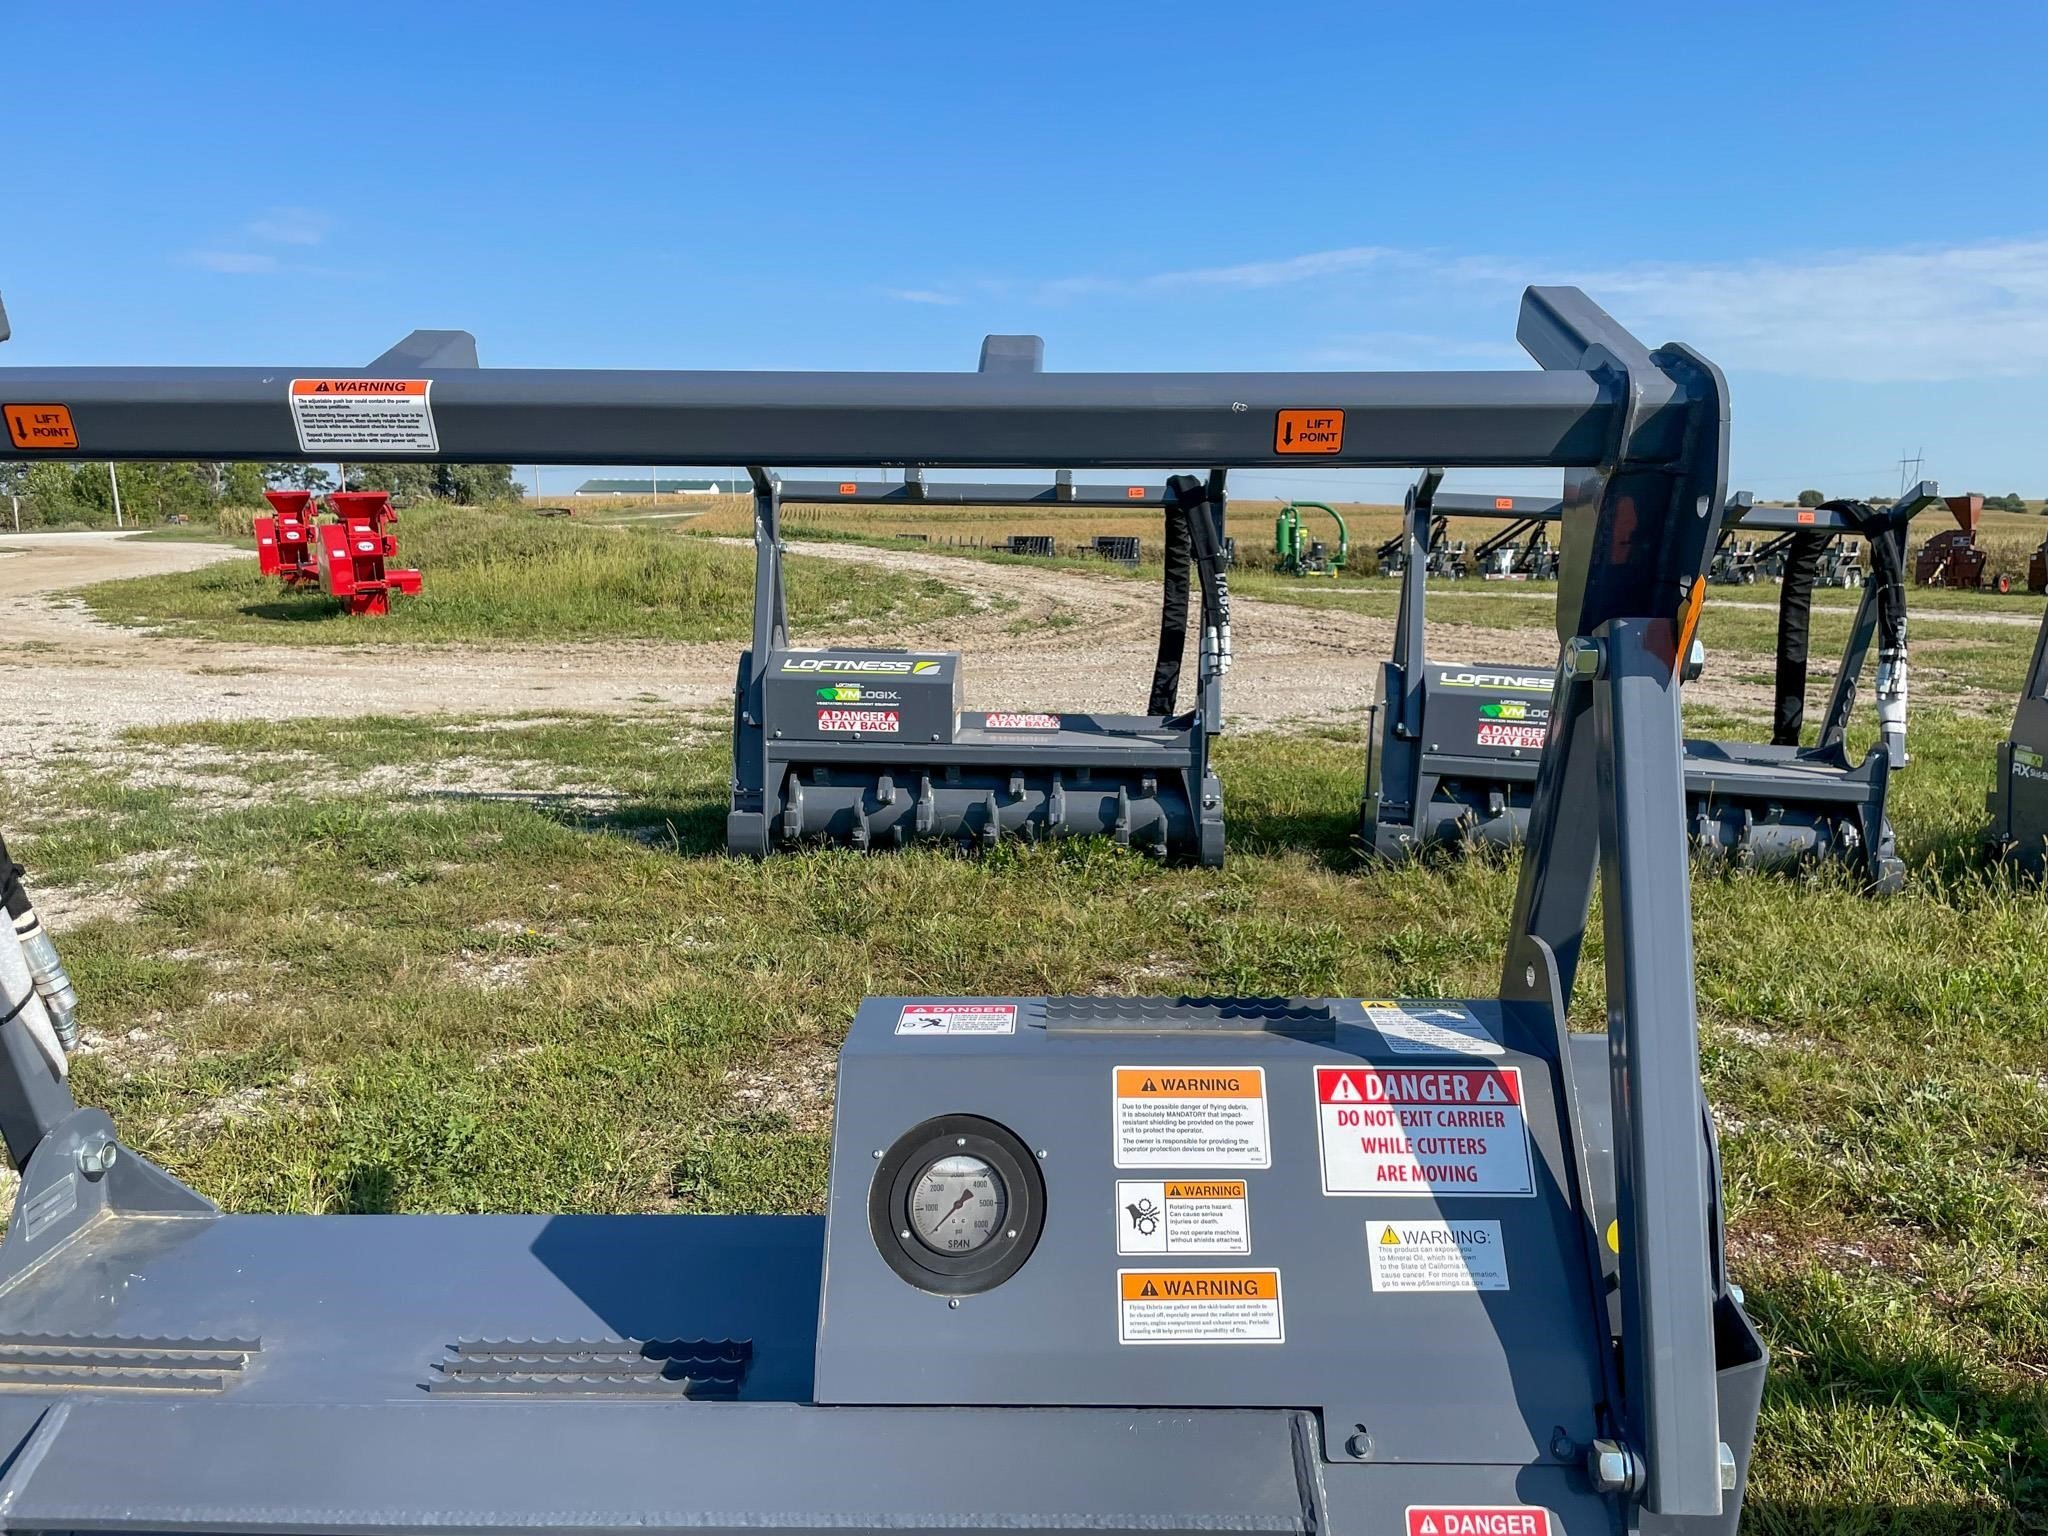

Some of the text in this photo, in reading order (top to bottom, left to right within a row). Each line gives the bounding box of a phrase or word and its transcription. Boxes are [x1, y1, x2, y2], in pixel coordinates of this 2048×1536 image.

[334, 382, 406, 392] WARNING
[34, 414, 60, 423] LIFT
[1307, 419, 1333, 428] LIFT
[32, 428, 70, 437] POINT
[1299, 433, 1338, 442] POINT
[783, 659, 913, 671] LOFTNESS
[1440, 672, 1555, 688] LOFTNES
[831, 711, 885, 721] DANGER
[1502, 708, 1549, 718] VMLOG
[821, 721, 896, 731] STAY BACK
[1481, 735, 1544, 747] STAY BA
[1161, 1078, 1240, 1091] WARNING
[1365, 1074, 1471, 1100] DANGER
[1338, 1110, 1505, 1128] DO NOT EXIT CARRIER
[1361, 1137, 1487, 1154] WHILE CUTTERS
[1376, 1165, 1478, 1182] ARE MOVING
[930, 1184, 944, 1192] 2000
[1184, 1186, 1241, 1196] WARNING
[925, 1204, 939, 1212] 1000
[1402, 1230, 1491, 1244] WARNING:
[948, 1240, 970, 1248] SPAN
[1163, 1280, 1258, 1296] WARNING
[1381, 1281, 1391, 1289] go
[1444, 1515, 1537, 1535] DANGER
